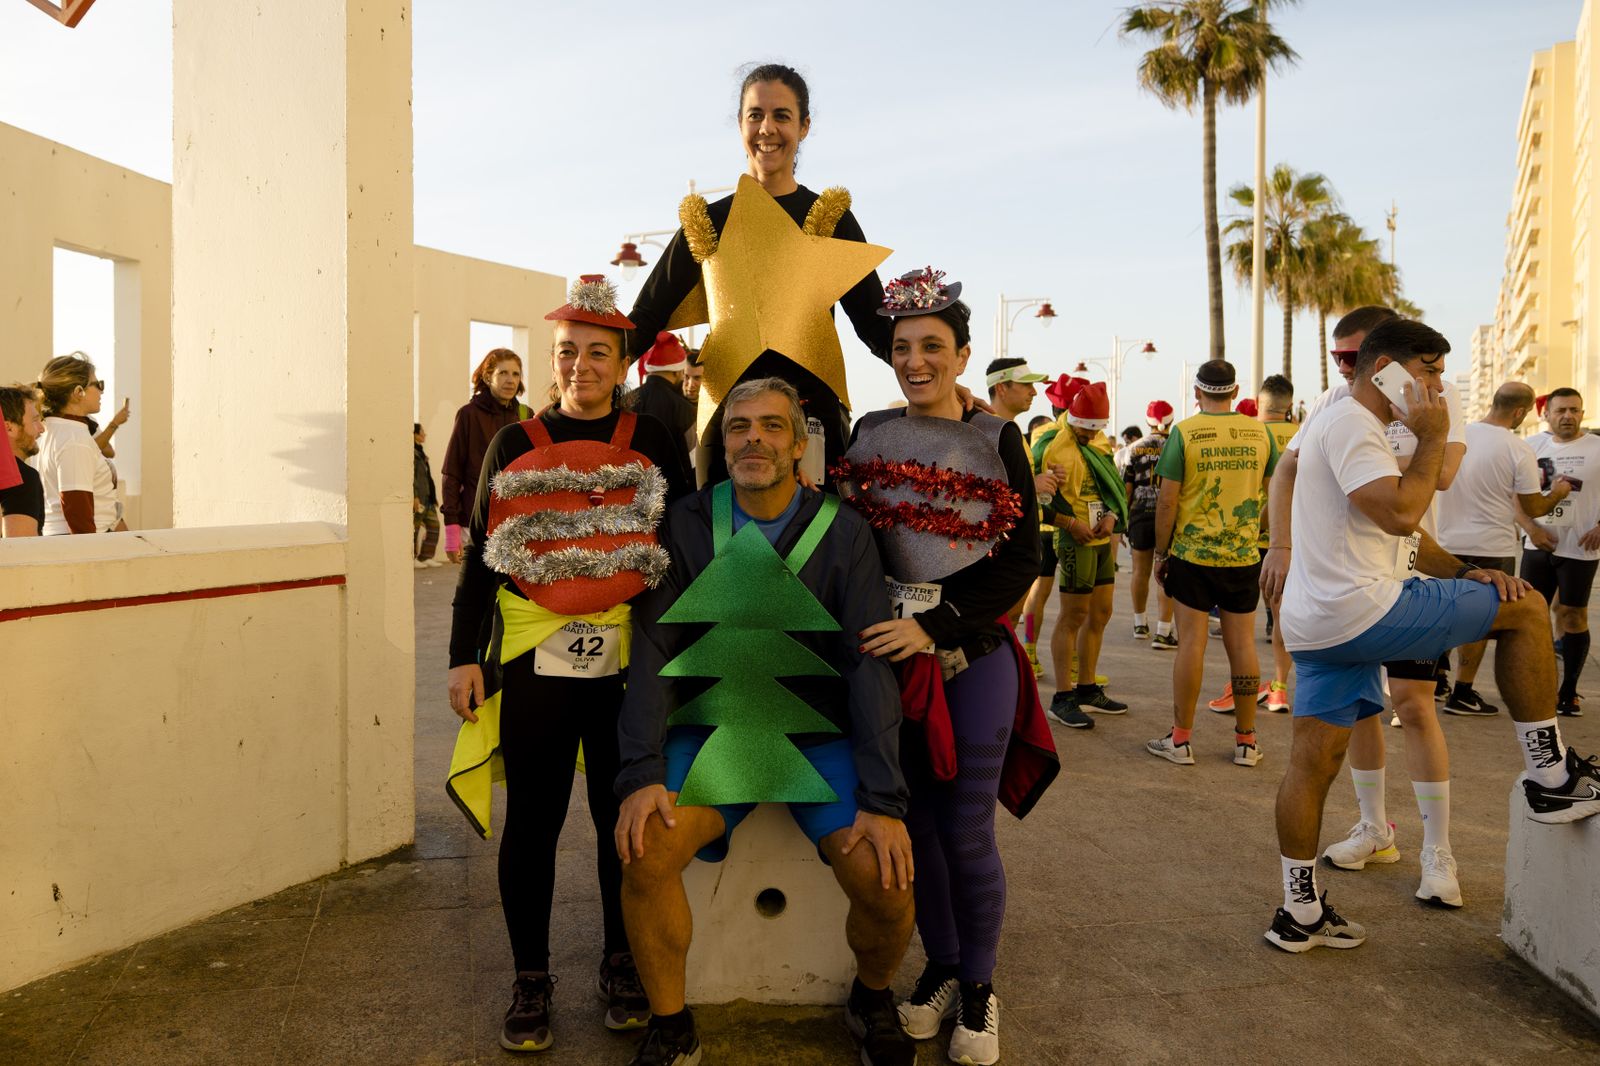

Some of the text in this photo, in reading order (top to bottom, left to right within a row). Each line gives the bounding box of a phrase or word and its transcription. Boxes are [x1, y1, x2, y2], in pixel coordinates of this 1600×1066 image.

[1201, 446, 1257, 458] RUNNERS
[1196, 458, 1259, 472] BARREÑOS
[586, 627, 599, 635] DE
[567, 636, 605, 657] 42
